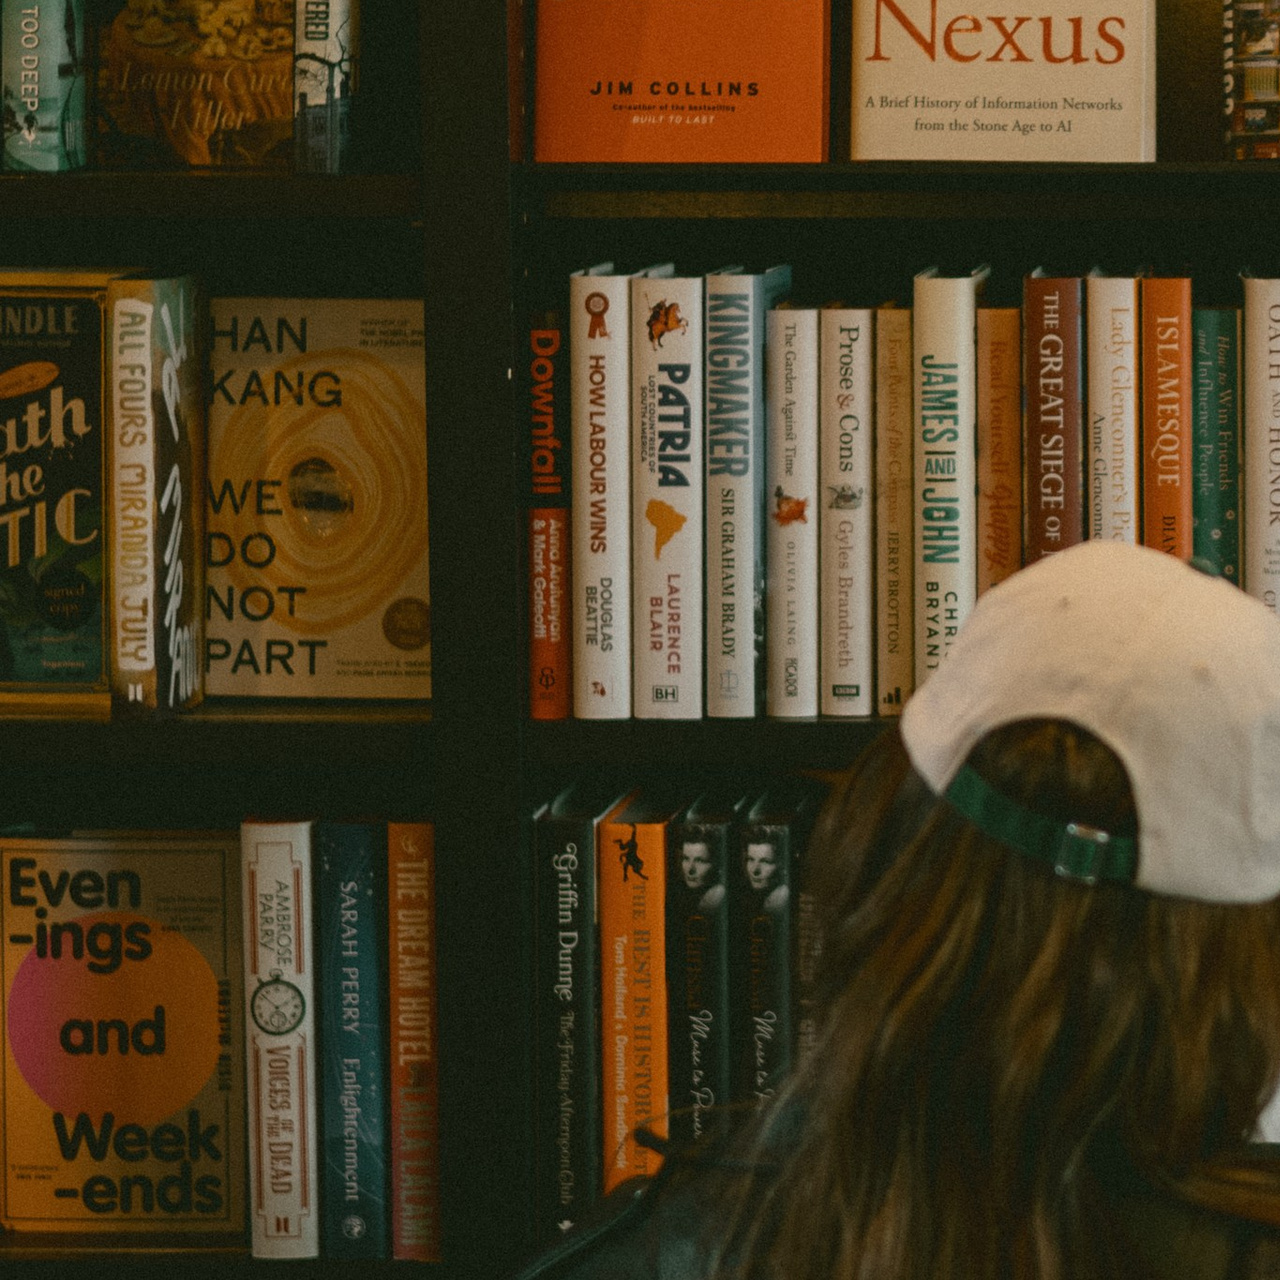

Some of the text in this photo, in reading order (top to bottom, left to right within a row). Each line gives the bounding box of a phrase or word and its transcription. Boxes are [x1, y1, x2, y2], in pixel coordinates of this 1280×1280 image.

[22, 5, 38, 48] TOO
[21, 55, 38, 110] DEEP
[591, 82, 760, 96] JIM COLLINS
[866, 96, 1123, 111] A Brief History of Information Networks
[211, 319, 307, 352] HAN
[784, 326, 796, 349] The
[209, 372, 342, 407] KANG
[709, 293, 750, 477] KINGMAKER
[784, 353, 796, 394] Garden
[836, 325, 859, 472] Prose & Cons
[529, 328, 561, 494] Downfall
[658, 363, 691, 487] PATRIA
[1041, 291, 1064, 509] THE GREAT SIEGE
[1150, 317, 1180, 487] ISLAMESQUE
[588, 356, 606, 553] HOW LABOUR WINS
[783, 446, 796, 477] Time
[921, 356, 960, 563] JAMES AND JOHN
[118, 312, 147, 662] ALL FOURS MIRANDA JULY
[208, 480, 282, 515] WE
[207, 533, 276, 567] DO
[205, 587, 306, 621] NOT
[650, 597, 662, 651] BLAIR
[667, 575, 681, 673] LAURENCE
[205, 640, 327, 675] PART
[10, 858, 141, 907] Even
[553, 843, 579, 1002] Griffin Dunne
[340, 881, 359, 1034] SARAH PERRY
[60, 1006, 167, 1055] and
[53, 1111, 222, 1161] Week
[340, 1058, 360, 1201] Enlightenment
